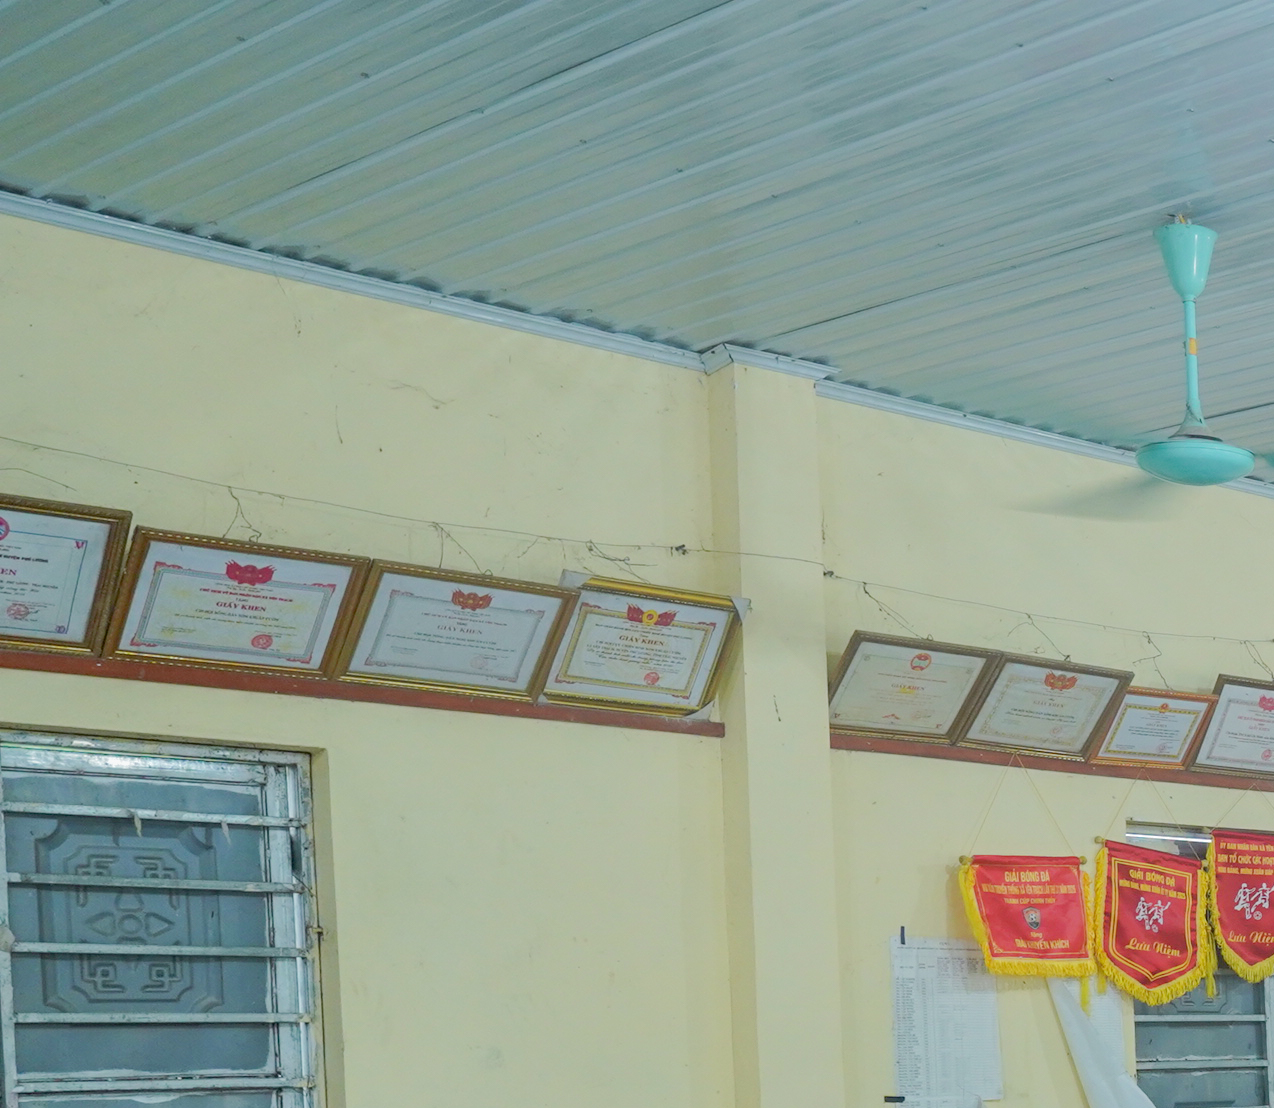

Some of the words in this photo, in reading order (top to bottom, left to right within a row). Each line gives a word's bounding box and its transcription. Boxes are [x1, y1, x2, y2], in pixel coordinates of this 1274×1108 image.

[241, 603, 267, 613] KHEN
[1004, 869, 1019, 882] GIẢI
[1020, 870, 1039, 882] BÓNG
[1040, 869, 1050, 882] ĐÁ
[1129, 868, 1144, 880] GIẢI
[1145, 871, 1165, 884] BÓNG
[1165, 876, 1176, 887] ĐÁ
[1228, 930, 1247, 943] Lưu
[1051, 939, 1070, 949] KHÍCH
[1125, 937, 1151, 951] Lưu
[1153, 941, 1181, 958] Niệm
